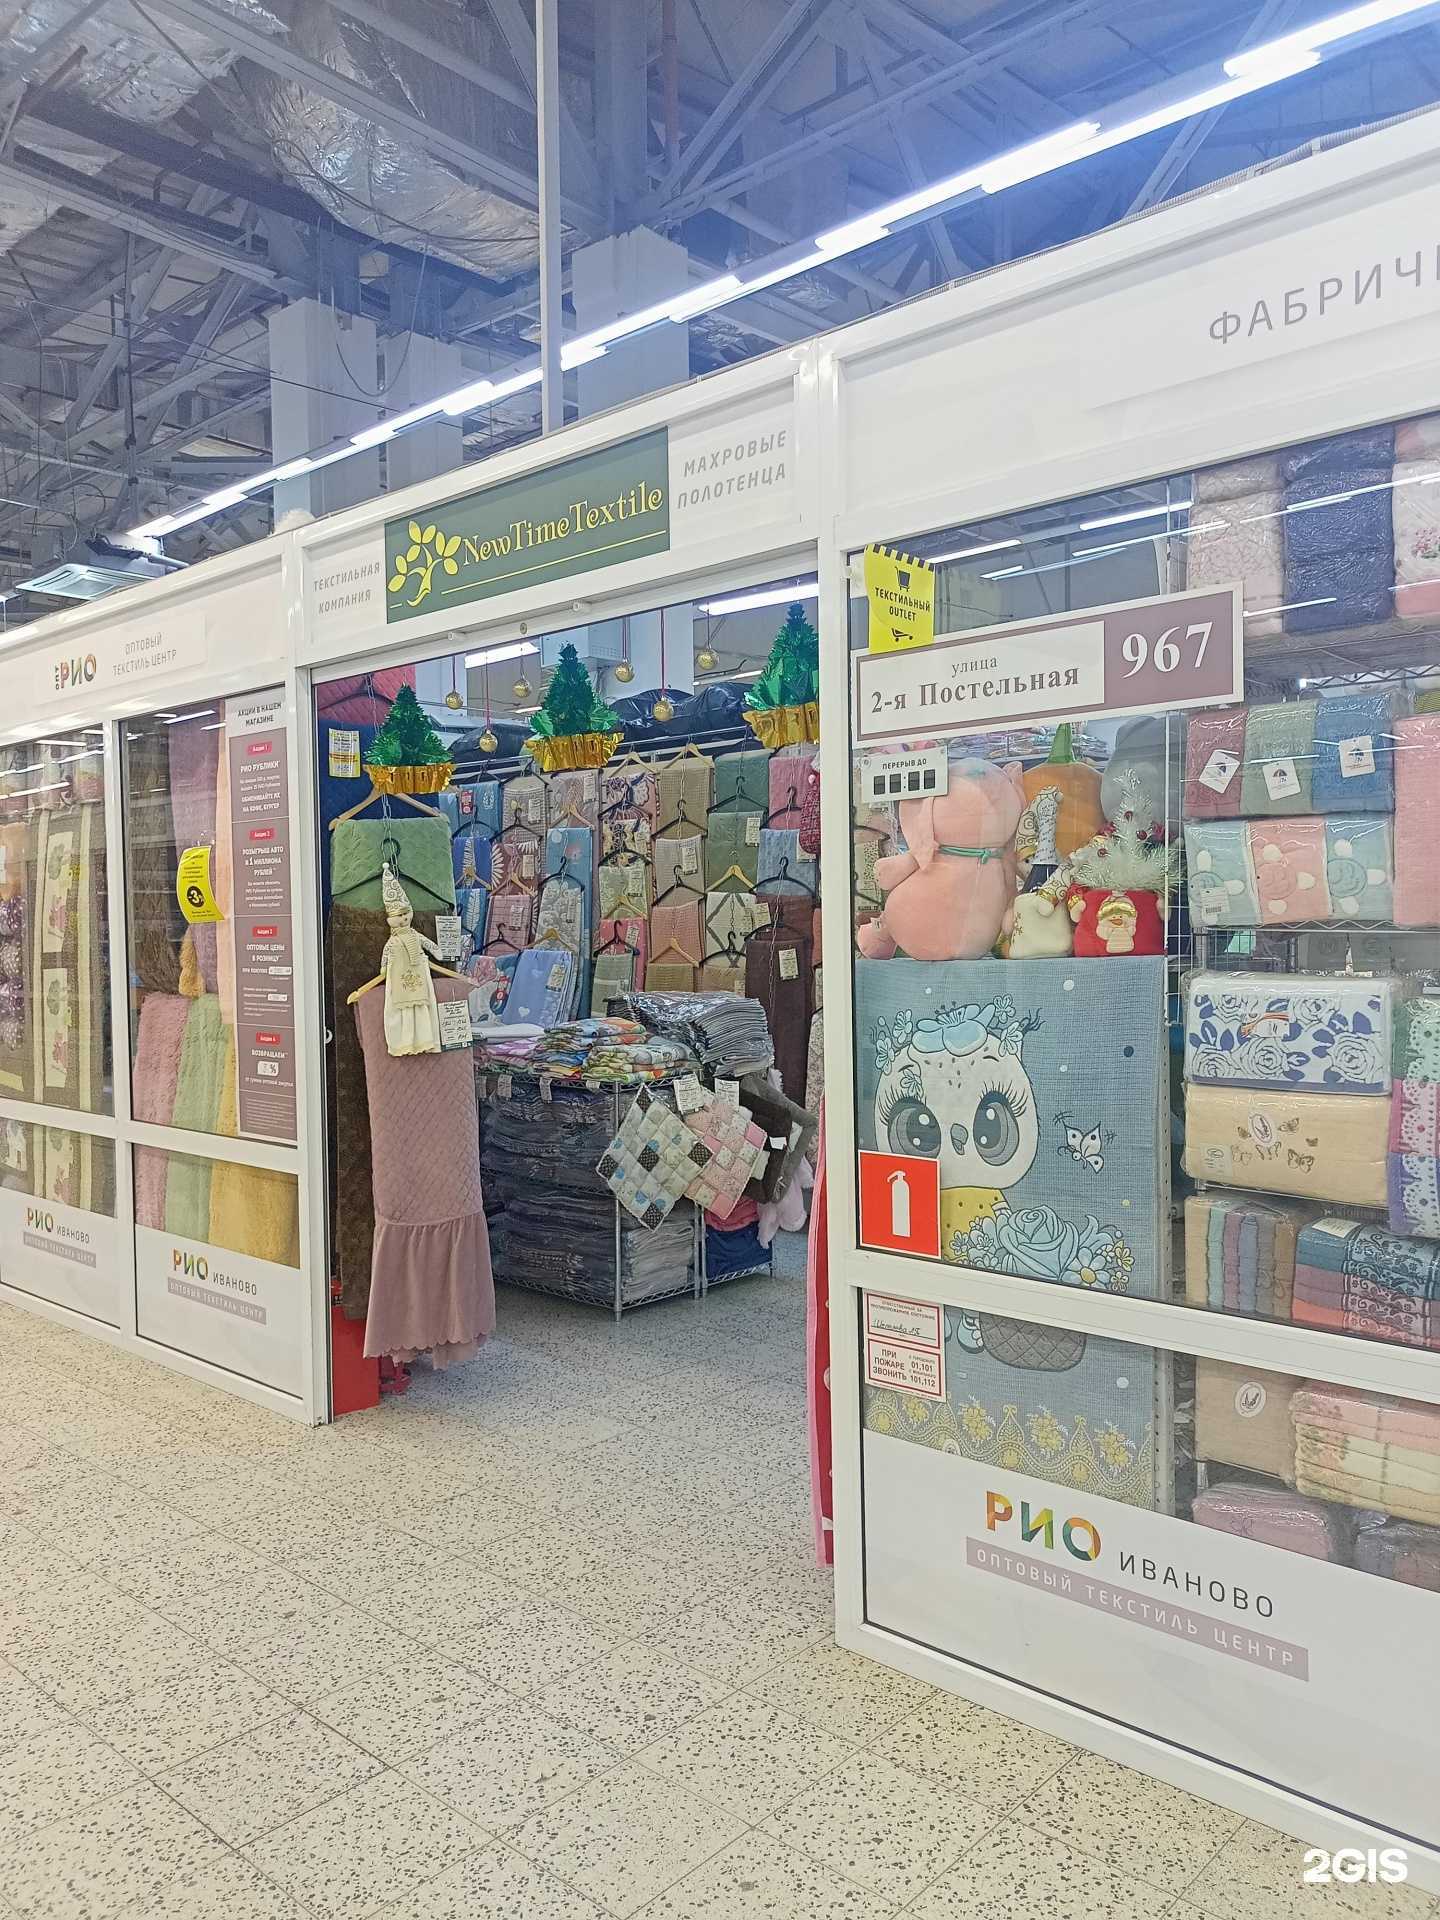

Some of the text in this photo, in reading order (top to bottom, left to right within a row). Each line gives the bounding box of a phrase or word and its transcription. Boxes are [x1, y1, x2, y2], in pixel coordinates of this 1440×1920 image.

[684, 430, 786, 477] МАХРОВЫЕ
[678, 463, 786, 509] ПОЛОТЕНЦА
[463, 480, 663, 566] NewTimeTextile
[314, 562, 380, 592] ТЕКСТИЛЬНАЯ
[319, 589, 371, 614] КОМПАНИЯ
[875, 586, 931, 612] ТЕКСТИЛЬНЫЙ
[889, 606, 917, 621] OUTLET
[125, 632, 162, 655] ОПТОВЫЙ
[1122, 621, 1214, 679] 967
[60, 653, 97, 689] РИО
[112, 649, 177, 676] ТЕКСТИЛЬ ЦЕНТР
[952, 657, 997, 678] улица
[871, 667, 1080, 713] 2-я Постельная
[238, 706, 255, 717] АКЦИИ
[261, 702, 282, 712] НАШЕМ
[246, 714, 274, 726] МАГАЗИНЕ
[240, 764, 252, 773] РИО
[882, 758, 927, 770] ПЕРЕРЫВ ДО
[270, 846, 284, 854] АВТО
[27, 1207, 90, 1244] РИО ИВАНОВО
[173, 1247, 257, 1296] РИО ИВАНОВО
[874, 1356, 905, 1370] ПОЖАРЕ
[881, 1348, 897, 1359] ПРИ
[872, 1366, 907, 1380] ЗВОНИТЬ
[910, 1375, 936, 1387] 101,112
[986, 1490, 1273, 1618] РИО ИВАНОВО
[977, 1548, 1294, 1666] ОПТОВЫЙ ТЕКСТИЛЬ ЦЕНТР
